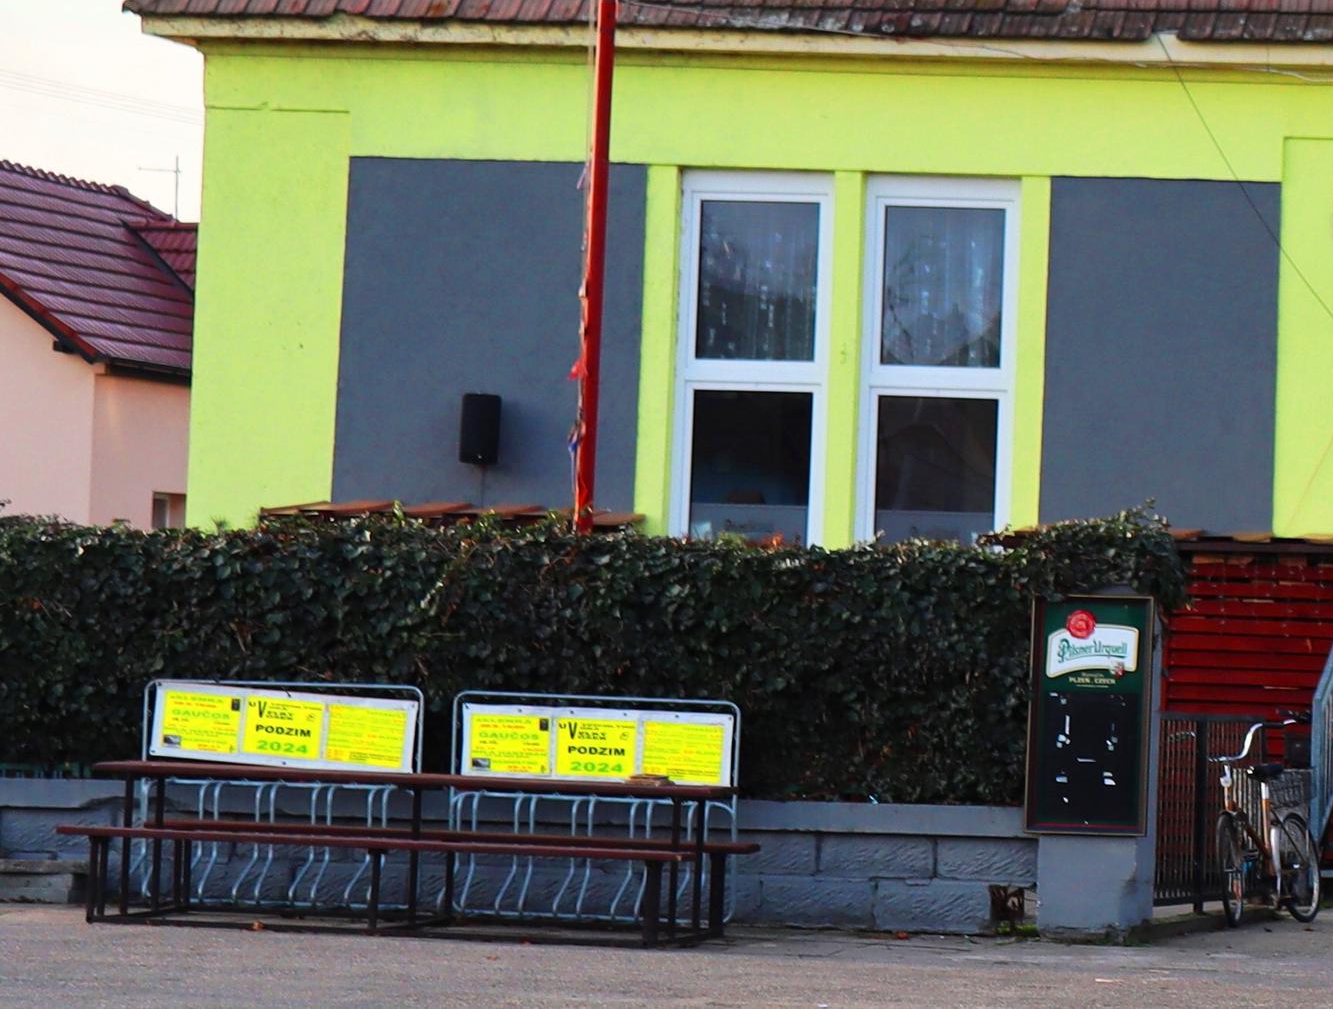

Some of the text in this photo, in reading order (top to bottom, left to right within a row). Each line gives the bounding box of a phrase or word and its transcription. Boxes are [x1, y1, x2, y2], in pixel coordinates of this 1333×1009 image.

[255, 724, 311, 738] PODZIM
[257, 740, 308, 755] 2024
[568, 745, 625, 756] PODZIM
[570, 761, 623, 773] 2024
